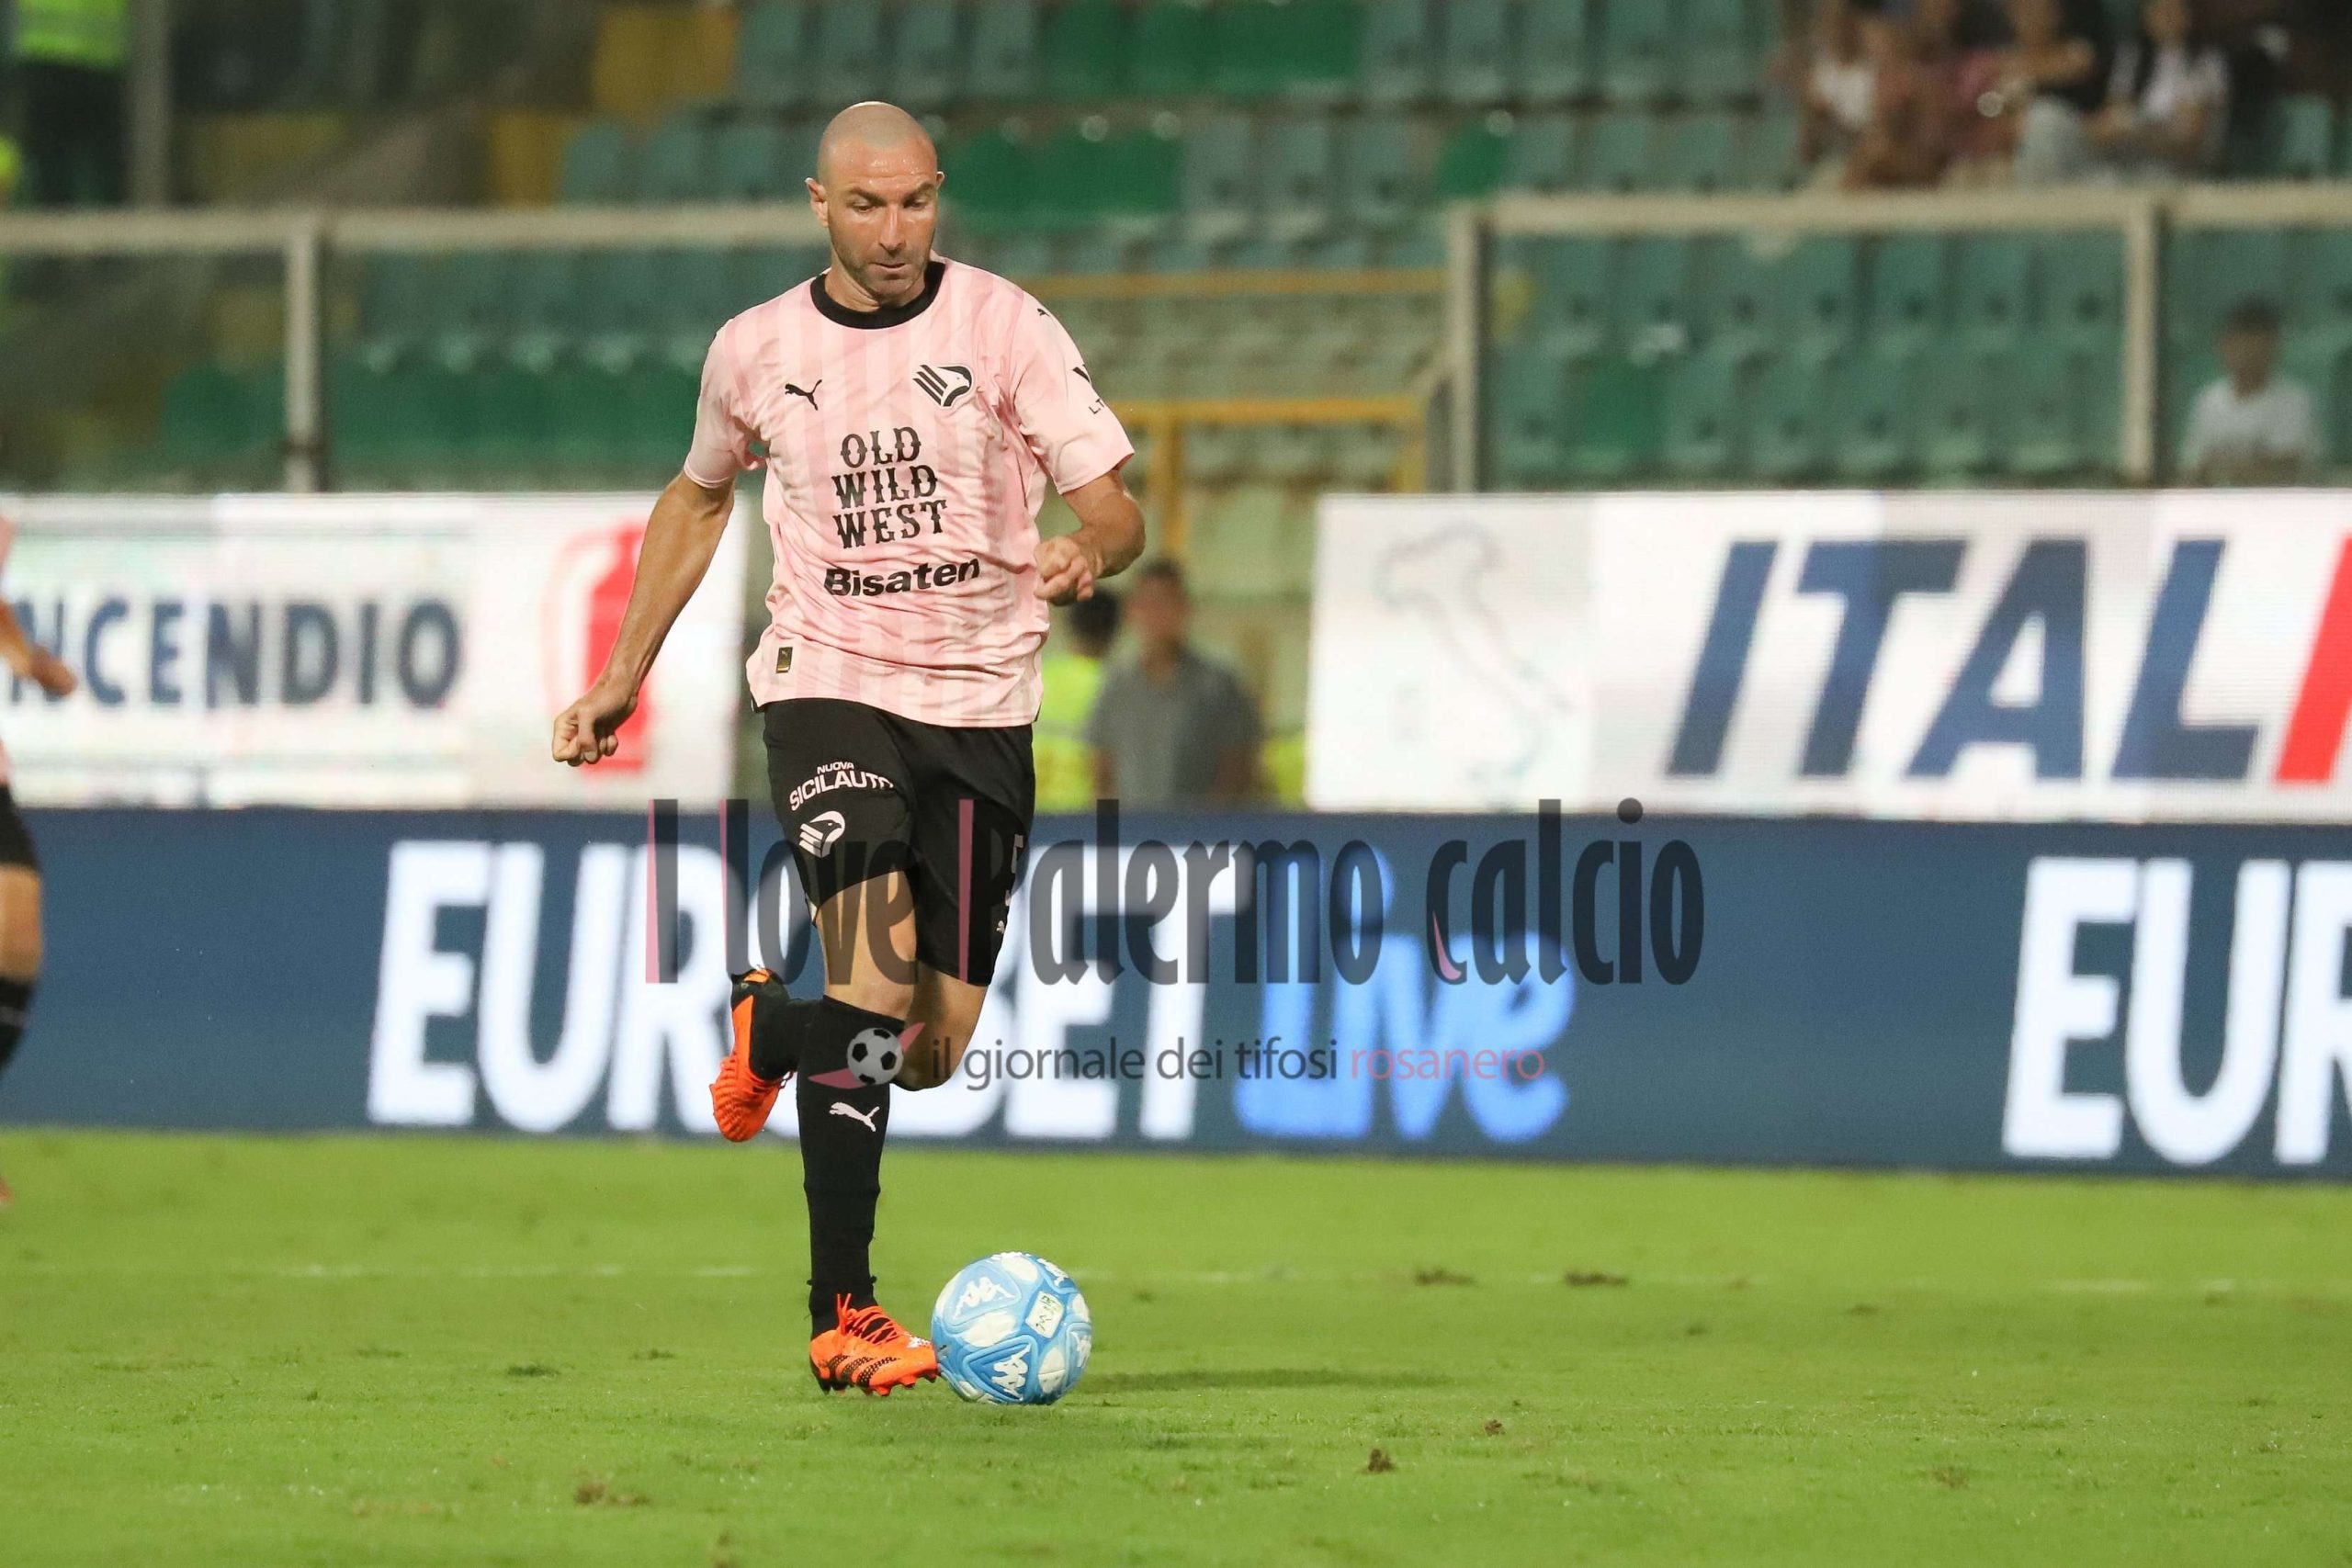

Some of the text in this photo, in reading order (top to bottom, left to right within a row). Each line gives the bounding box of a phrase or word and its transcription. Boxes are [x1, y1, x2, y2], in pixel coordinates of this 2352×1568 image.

[841, 426, 922, 468] OLD
[831, 464, 938, 510] WILD
[831, 499, 948, 549] WEST
[823, 558, 980, 597] Bisaten
[817, 761, 854, 774] NUOVA
